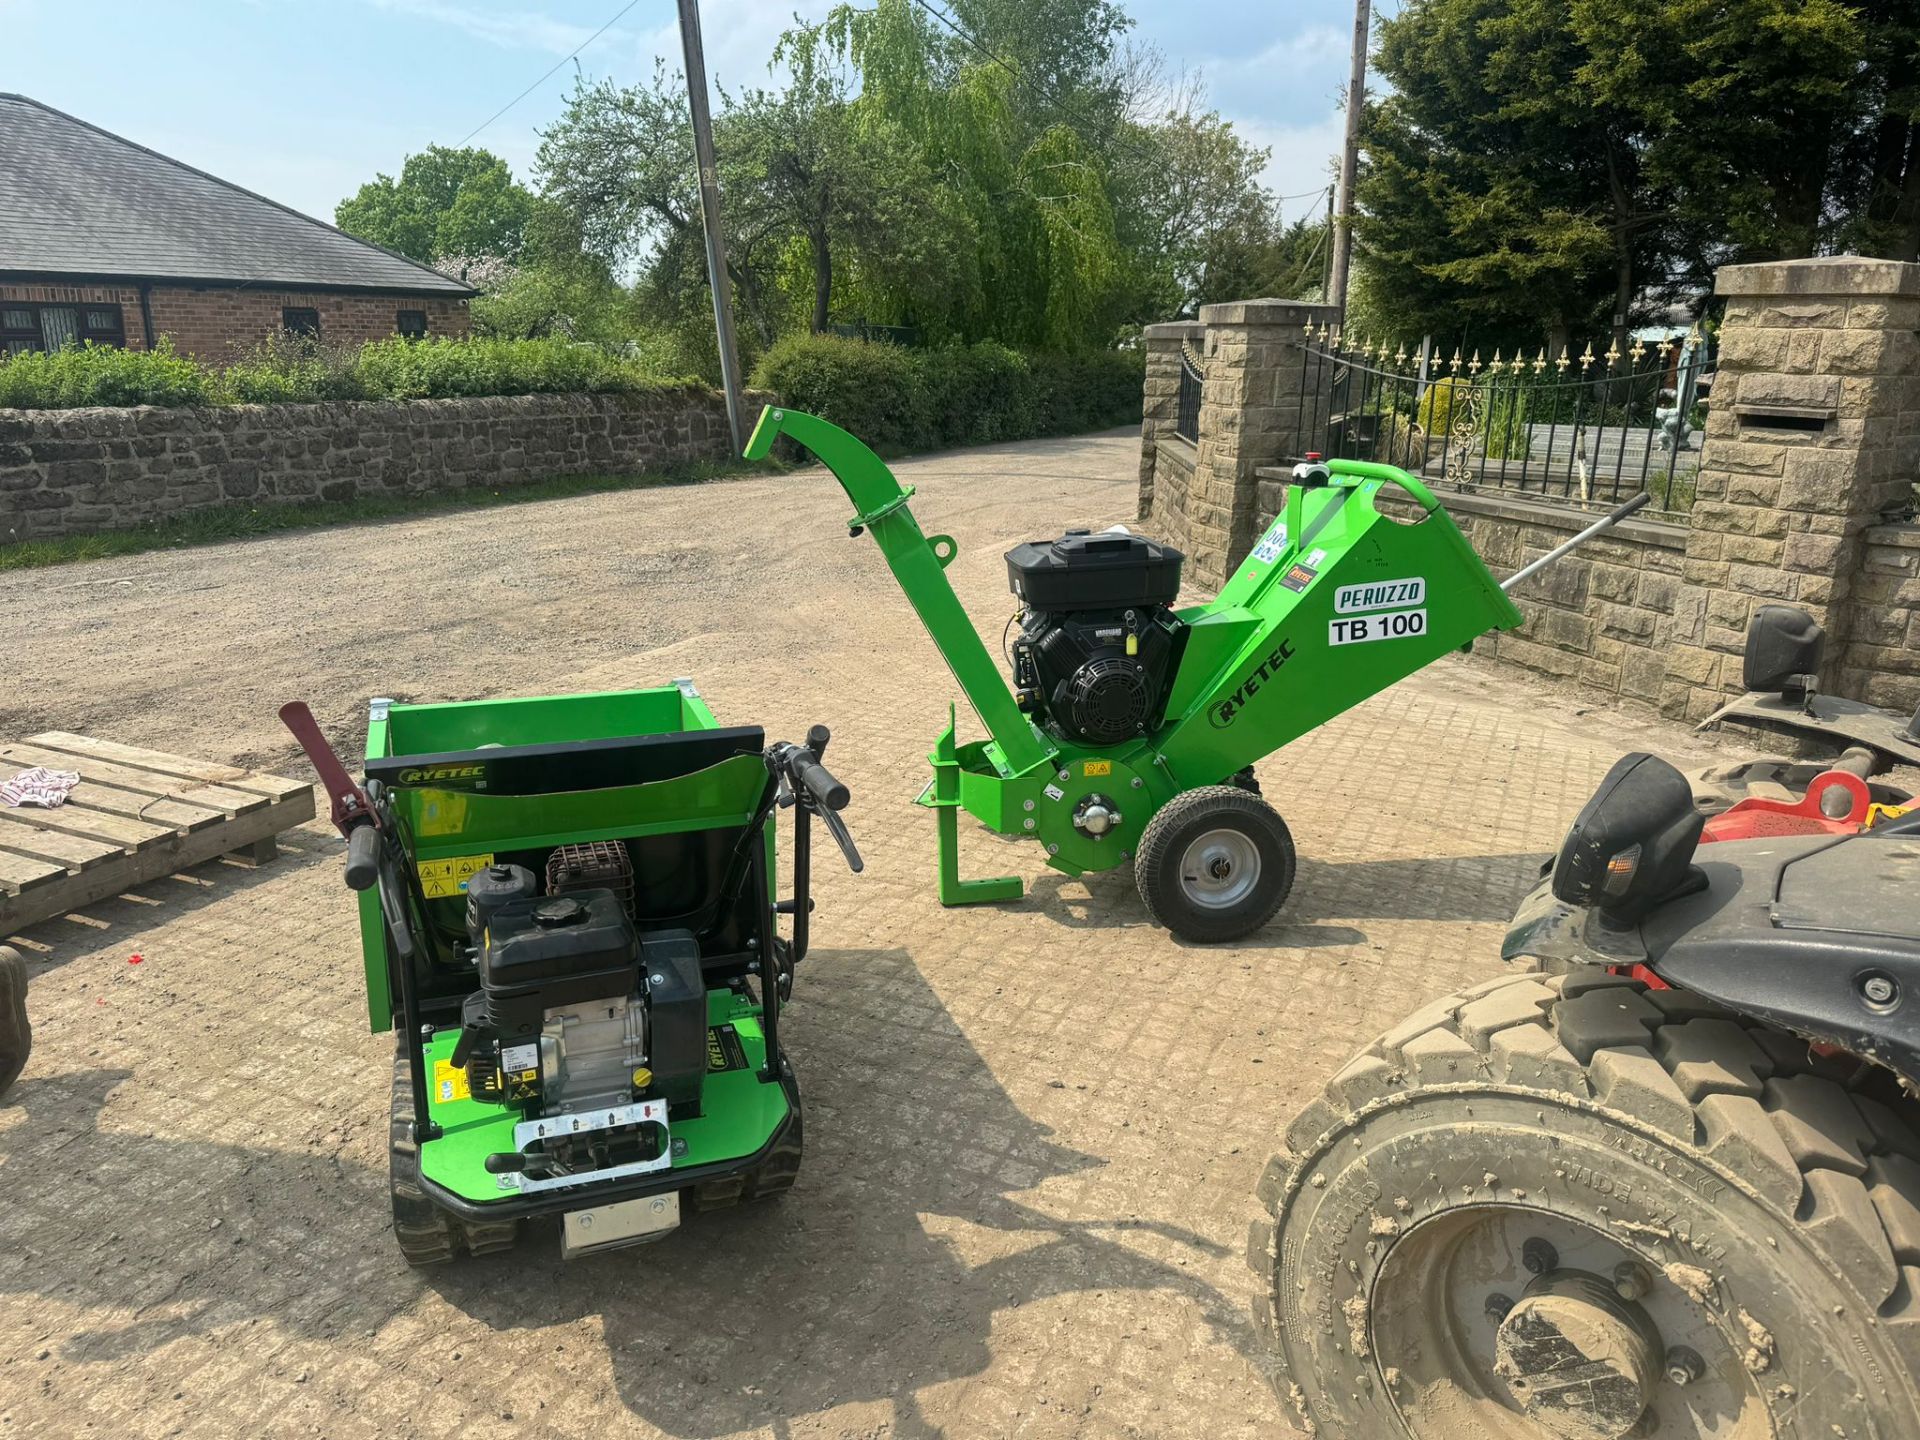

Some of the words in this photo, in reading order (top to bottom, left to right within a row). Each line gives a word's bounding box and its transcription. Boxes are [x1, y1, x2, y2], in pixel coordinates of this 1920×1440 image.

[1340, 582, 1420, 609] PERUZZO
[1332, 619, 1368, 642] TB
[1378, 613, 1423, 637] 100
[1216, 638, 1296, 724] RYETEC
[406, 766, 485, 782] RYETEC
[1629, 1136, 1695, 1179] BKT
